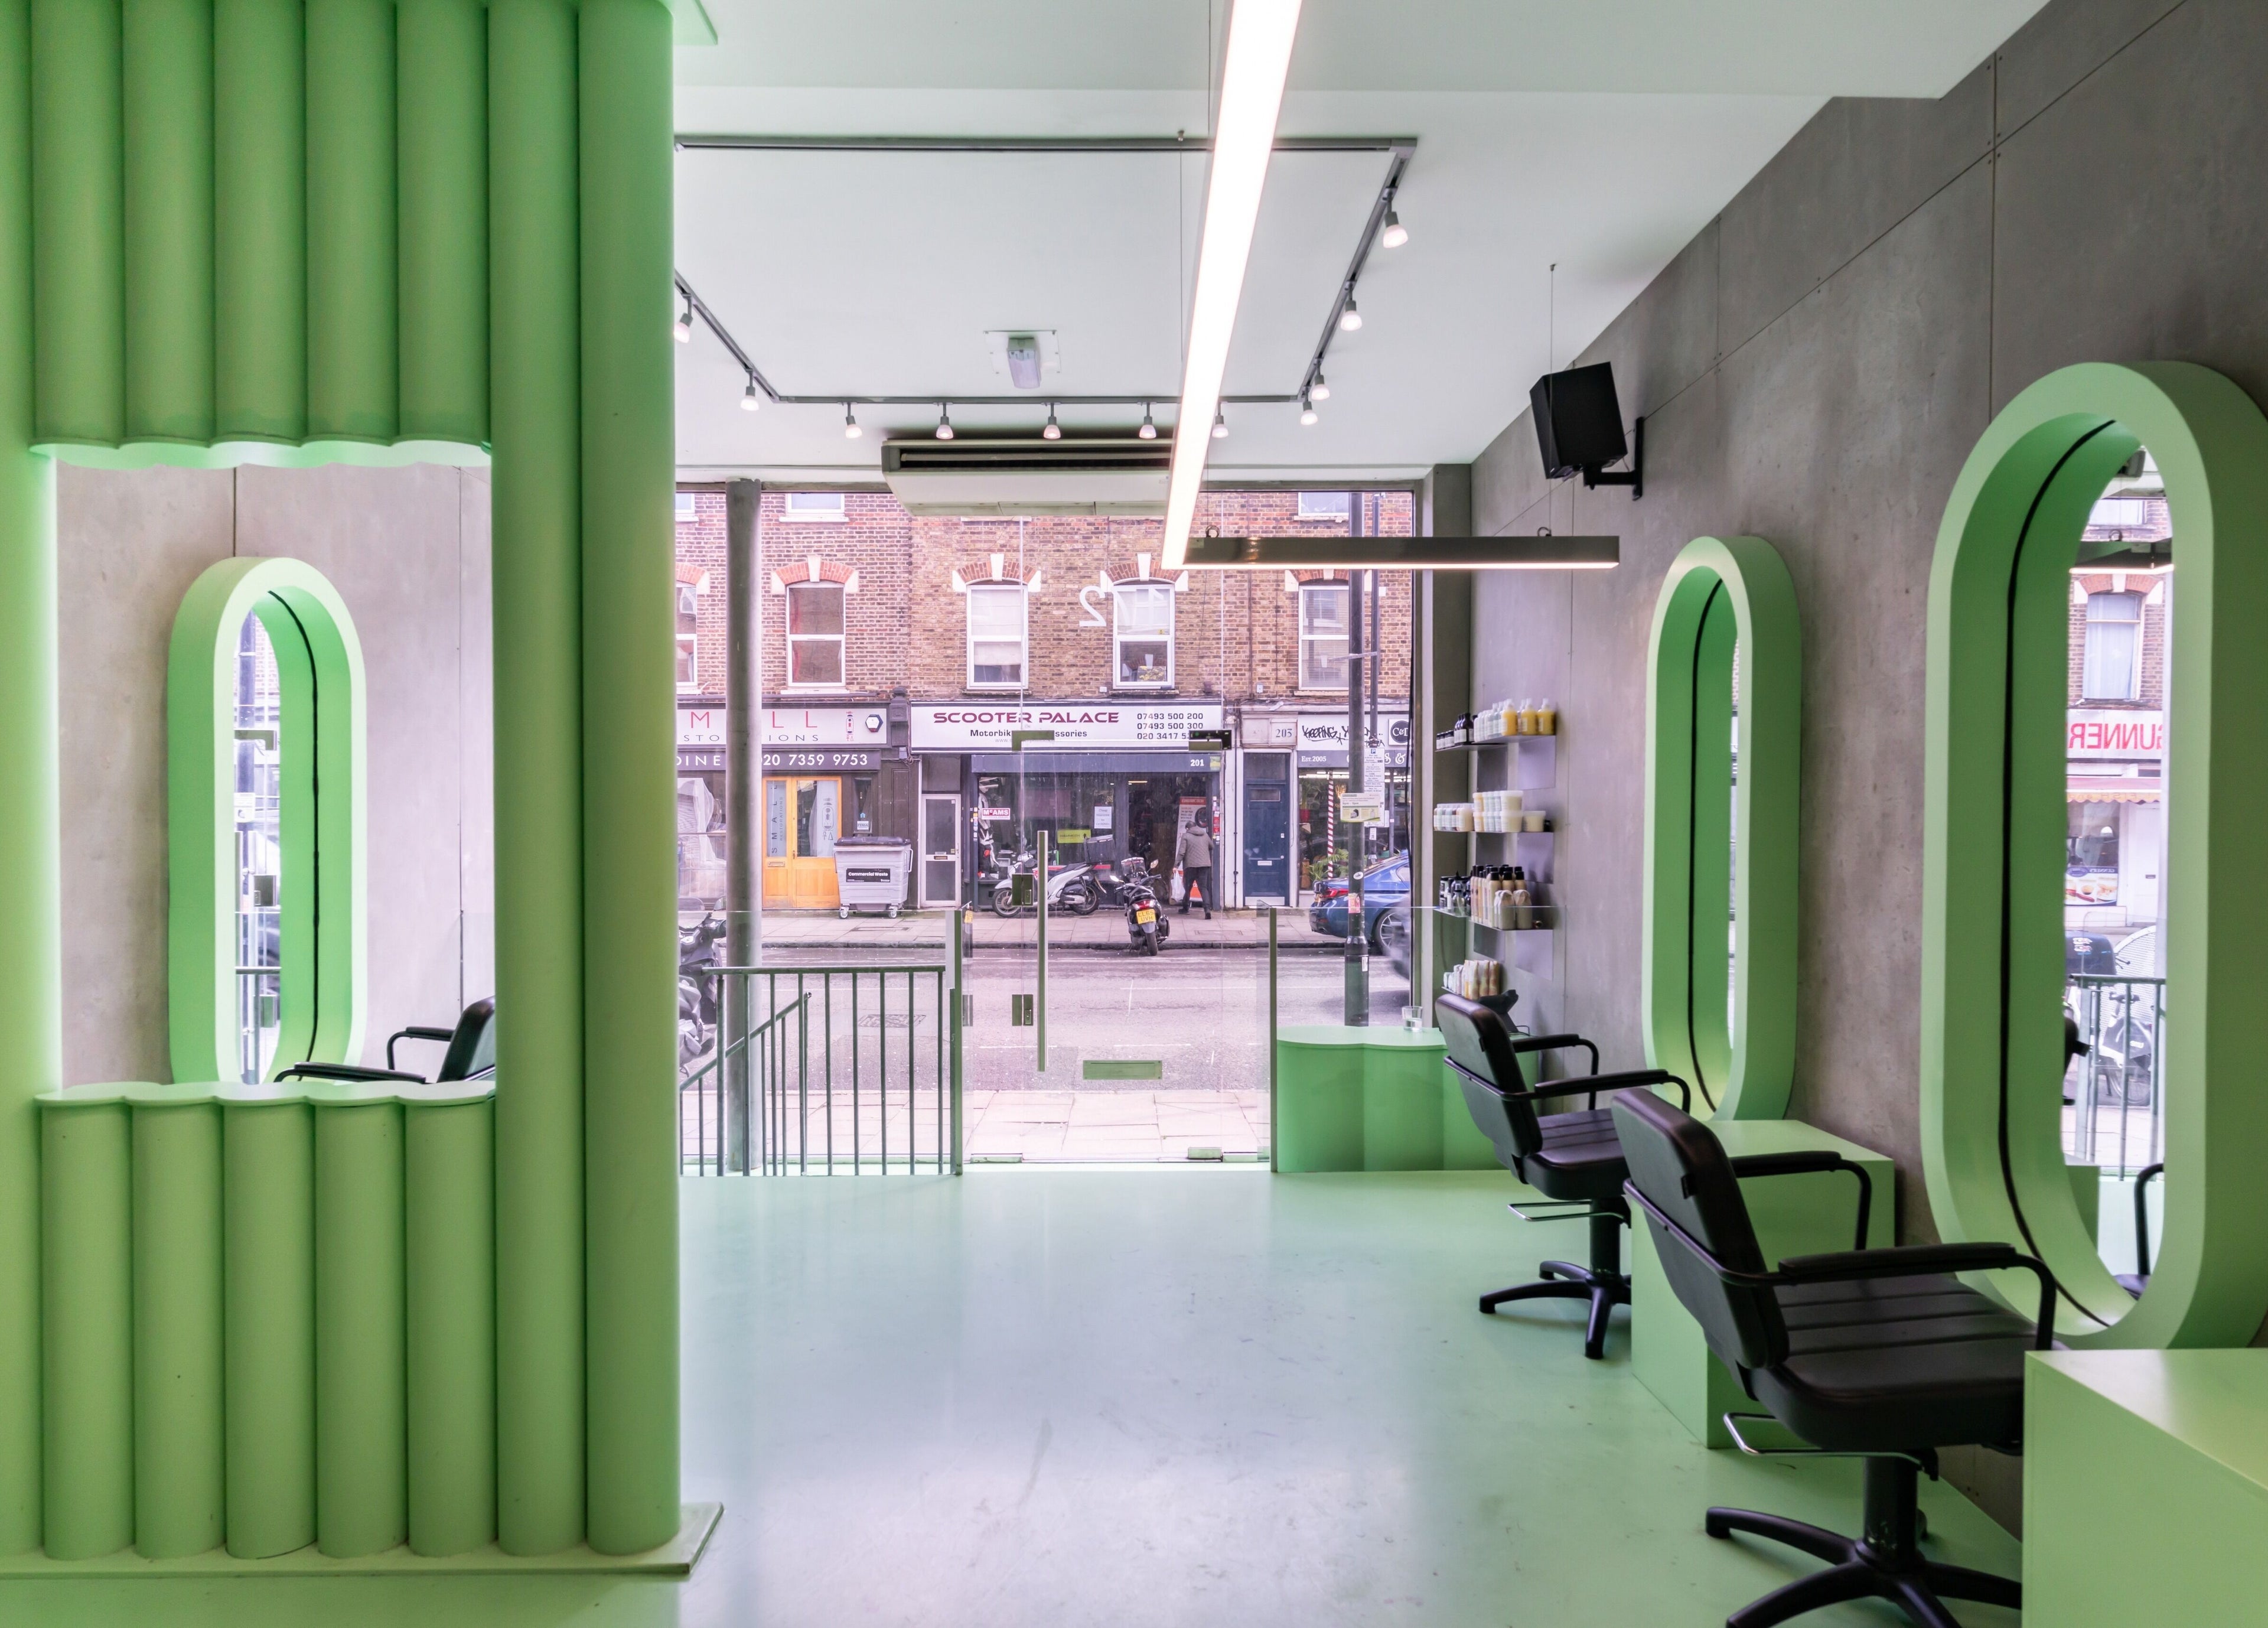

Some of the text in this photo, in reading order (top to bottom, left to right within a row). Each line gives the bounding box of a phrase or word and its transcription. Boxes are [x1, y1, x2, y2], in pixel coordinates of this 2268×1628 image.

[933, 712, 1119, 723] SCOOTER PALACE
[1276, 728, 1292, 738] 203
[760, 754, 868, 766] 20 7359 9753
